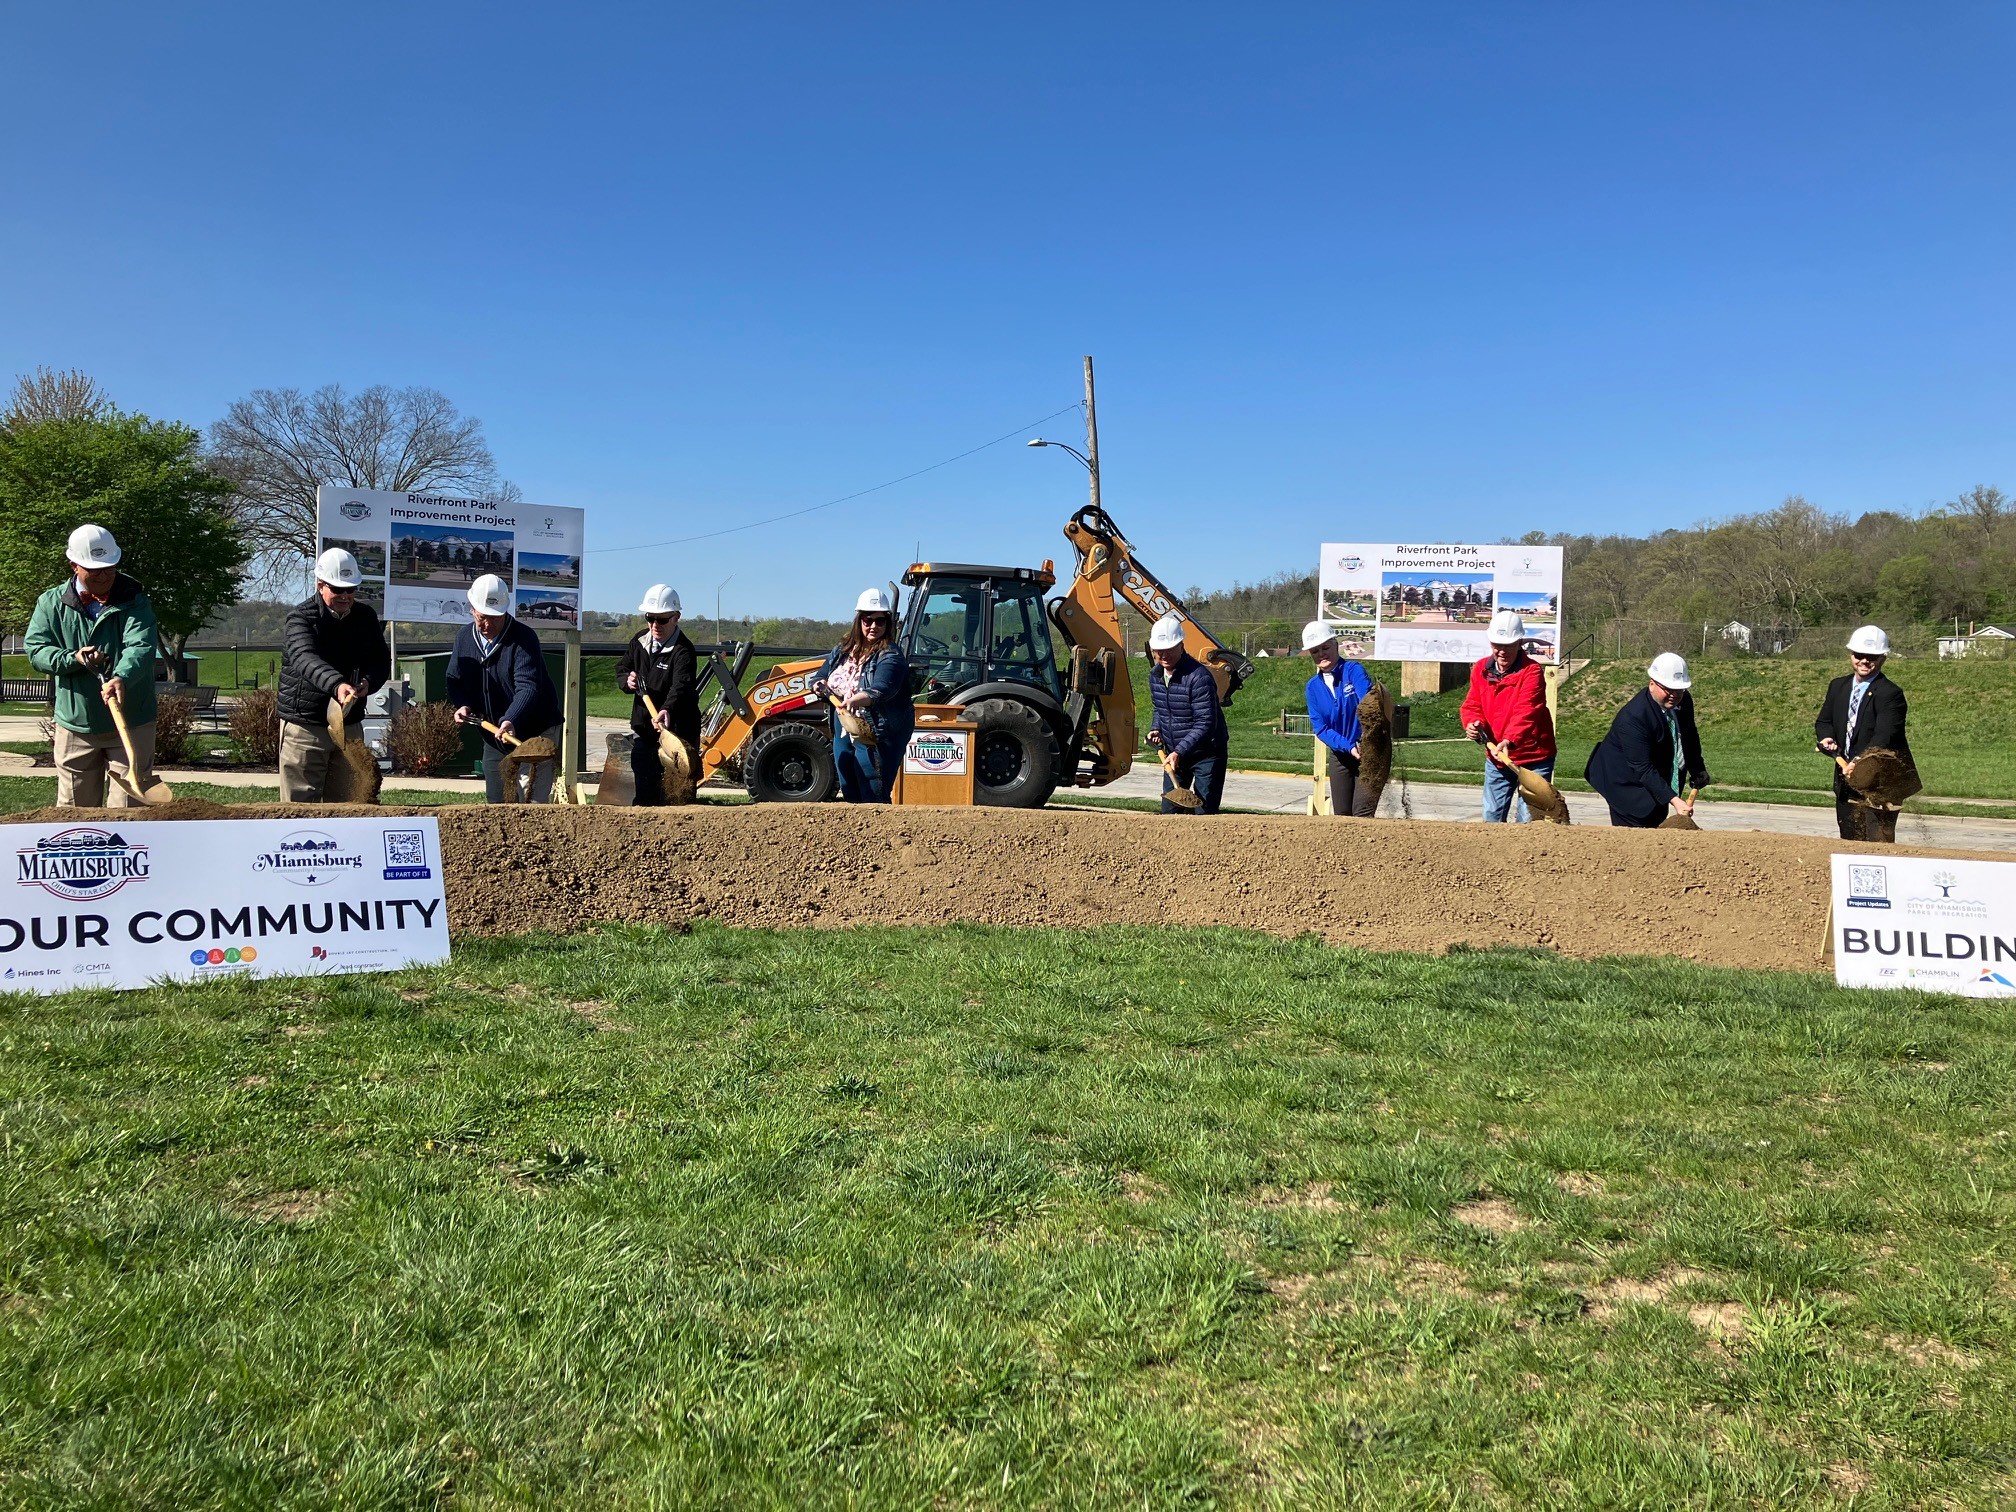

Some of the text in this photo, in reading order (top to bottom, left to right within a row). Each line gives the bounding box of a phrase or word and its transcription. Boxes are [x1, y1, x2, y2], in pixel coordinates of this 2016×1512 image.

[408, 493, 498, 511] Riverfront Park
[390, 507, 516, 527] Improvement Project
[1396, 545, 1478, 555] Riverfront Park
[1381, 558, 1496, 570] Improvement Project
[908, 745, 964, 760] MIAMISBURG
[17, 850, 150, 881] MIAMISBURG
[251, 852, 363, 872] Miamisburg
[51, 880, 117, 896] OHIO'S STAR CITY
[1937, 904, 1987, 913] MIAMISBURG
[1941, 911, 1988, 919] RECREATION
[0, 898, 440, 953] OUR COMMUNITY
[1843, 927, 2016, 963] BUILDIN
[47, 968, 61, 976] Inc
[85, 963, 111, 971] CMTA
[1915, 968, 1960, 978] CHAMPLIN
